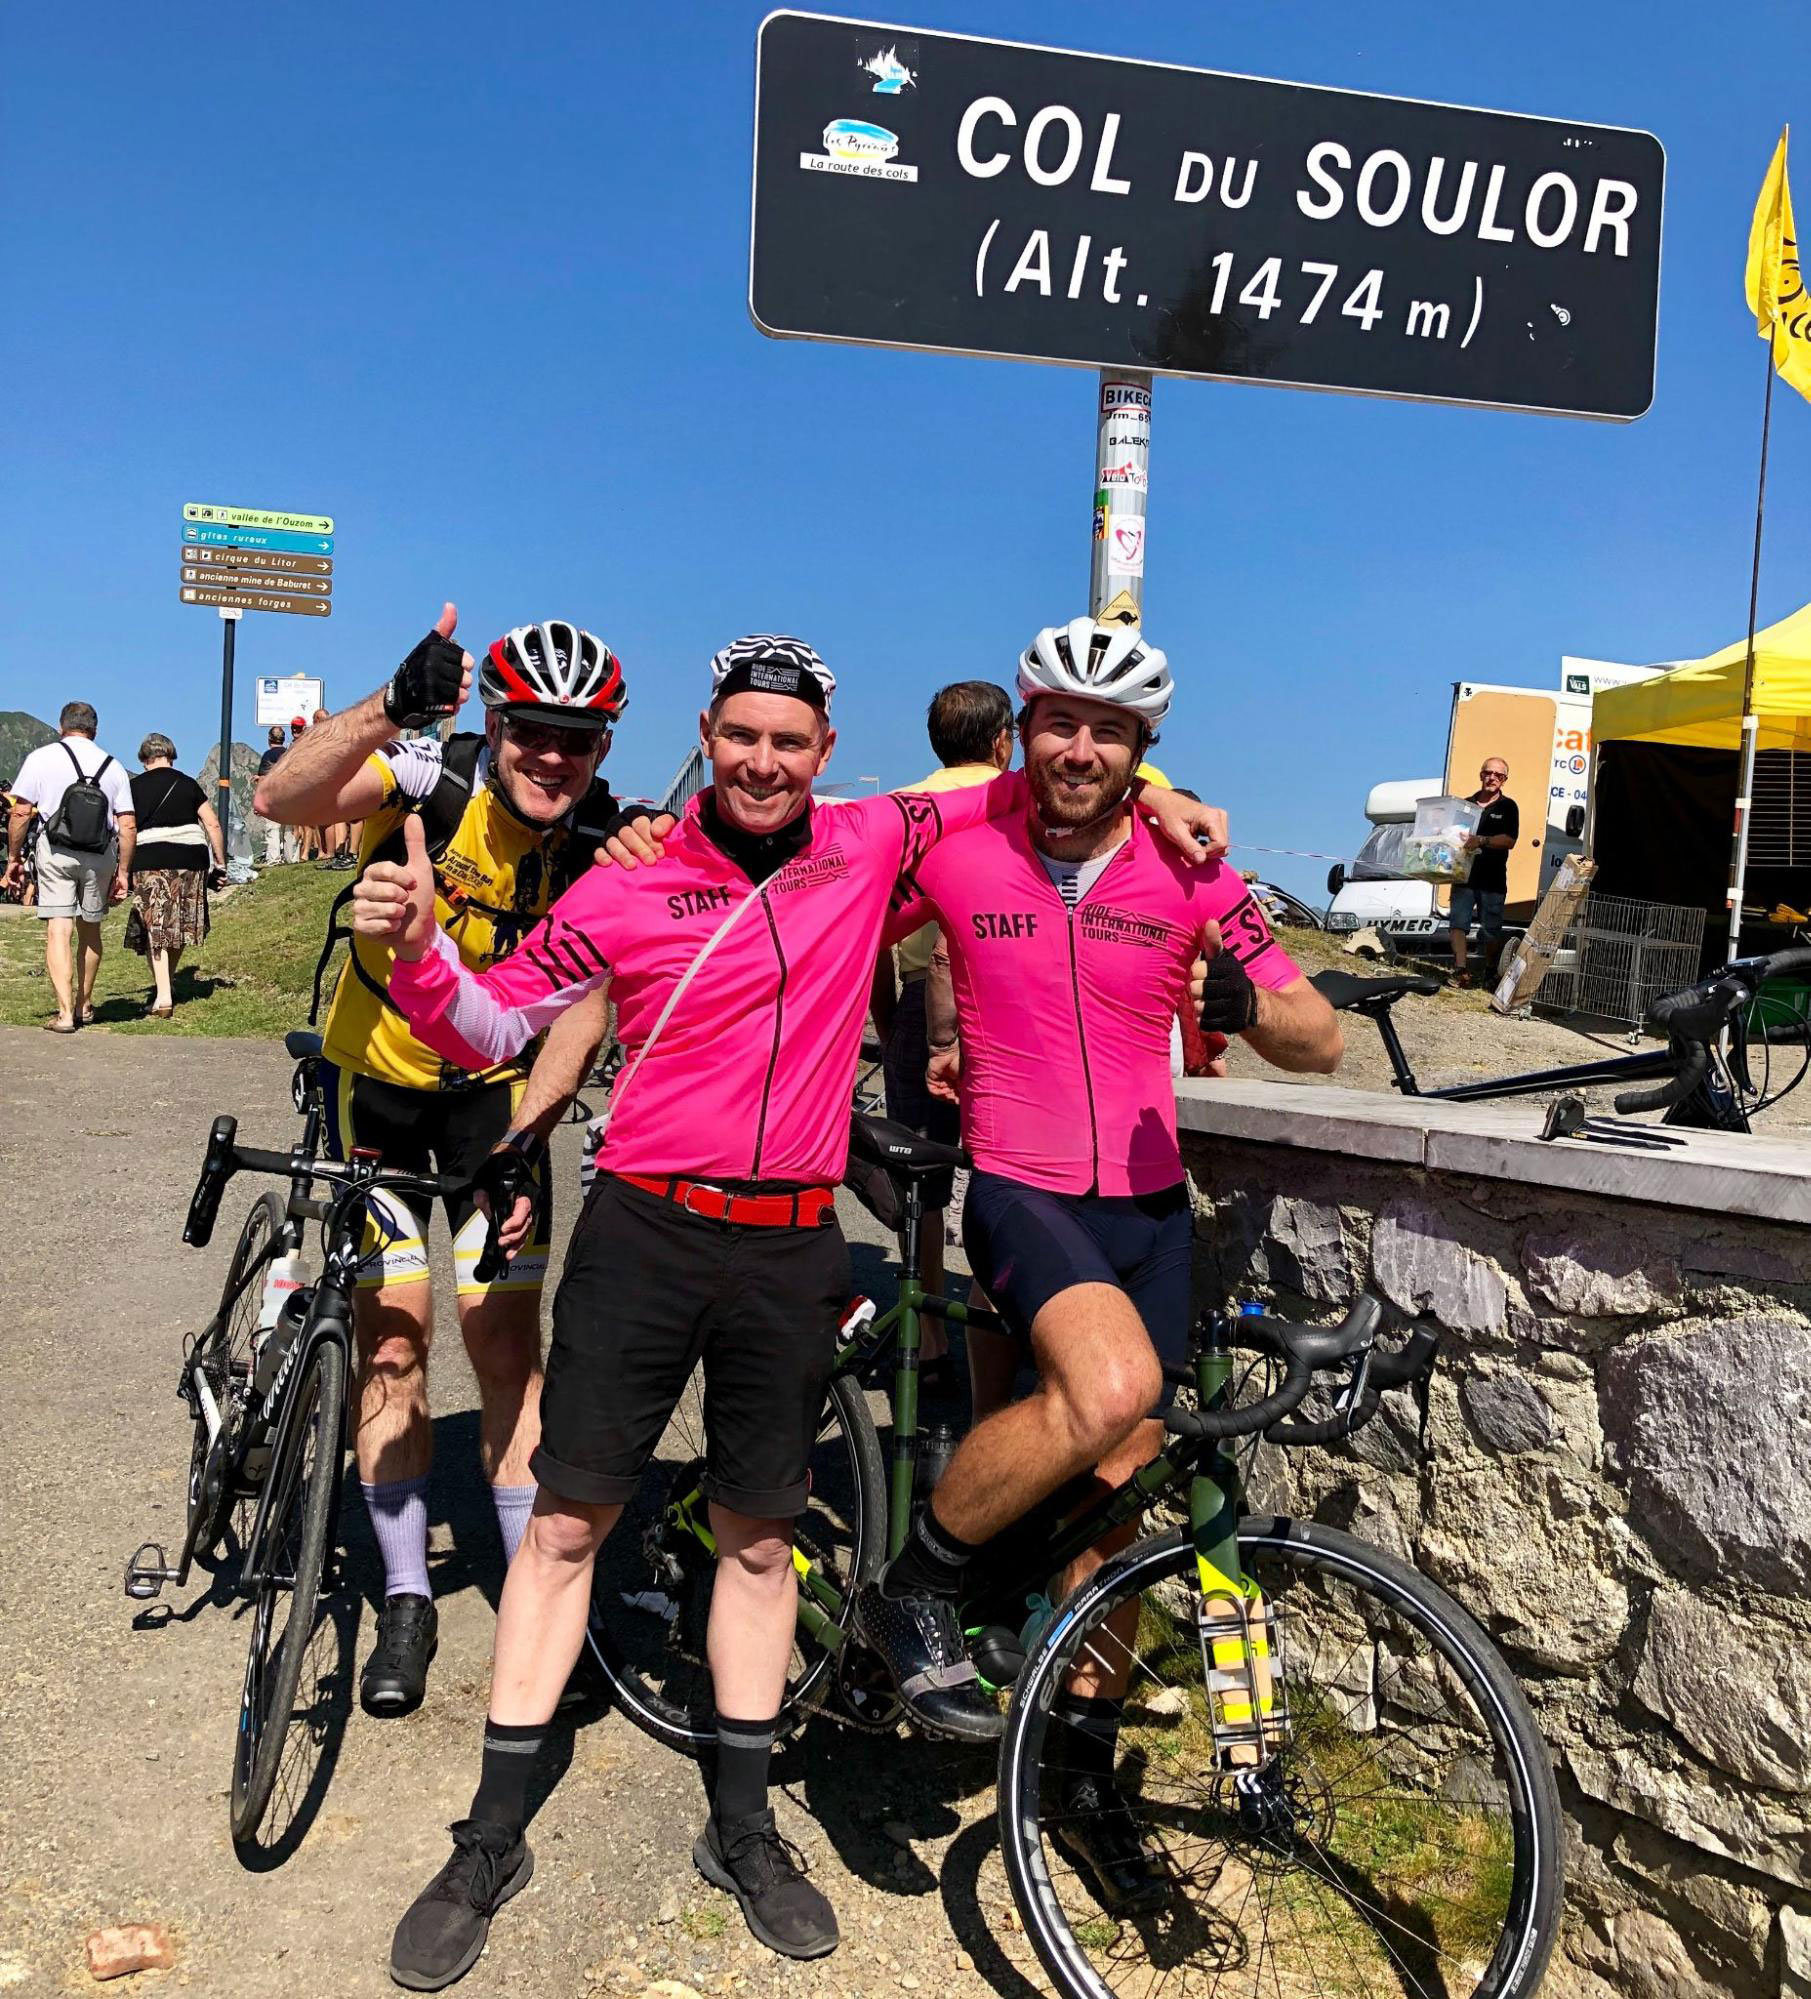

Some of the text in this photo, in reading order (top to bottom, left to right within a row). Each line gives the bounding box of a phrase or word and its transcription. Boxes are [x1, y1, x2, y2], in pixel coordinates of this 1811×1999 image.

[810, 158, 909, 180] La route des cols
[957, 96, 1638, 256] COL DU SOULOR
[976, 218, 1148, 306] (Alt.
[1210, 252, 1384, 330] 1474
[231, 512, 260, 522] vallée
[262, 515, 273, 524] de
[233, 534, 268, 545] ruraux
[215, 552, 297, 568] cirque du Litor
[199, 572, 312, 590] ancienne mine de Baburet
[199, 592, 292, 610] anciennes forges
[751, 663, 766, 673] RIDE
[750, 670, 799, 684] INTERNATIONAL
[750, 678, 771, 689] TOURS
[773, 877, 808, 894] TOURS
[667, 885, 732, 920] STAFF
[1084, 904, 1113, 918] RIDE
[972, 912, 1039, 940] STAFF
[1081, 914, 1168, 942] INTERNATIONAL
[1366, 918, 1434, 932] HYMER
[1081, 926, 1120, 943] TOURS
[888, 1144, 912, 1155] WTB
[1074, 1566, 1125, 1612] MARATHON
[1019, 1648, 1048, 1708] SCHWALBE
